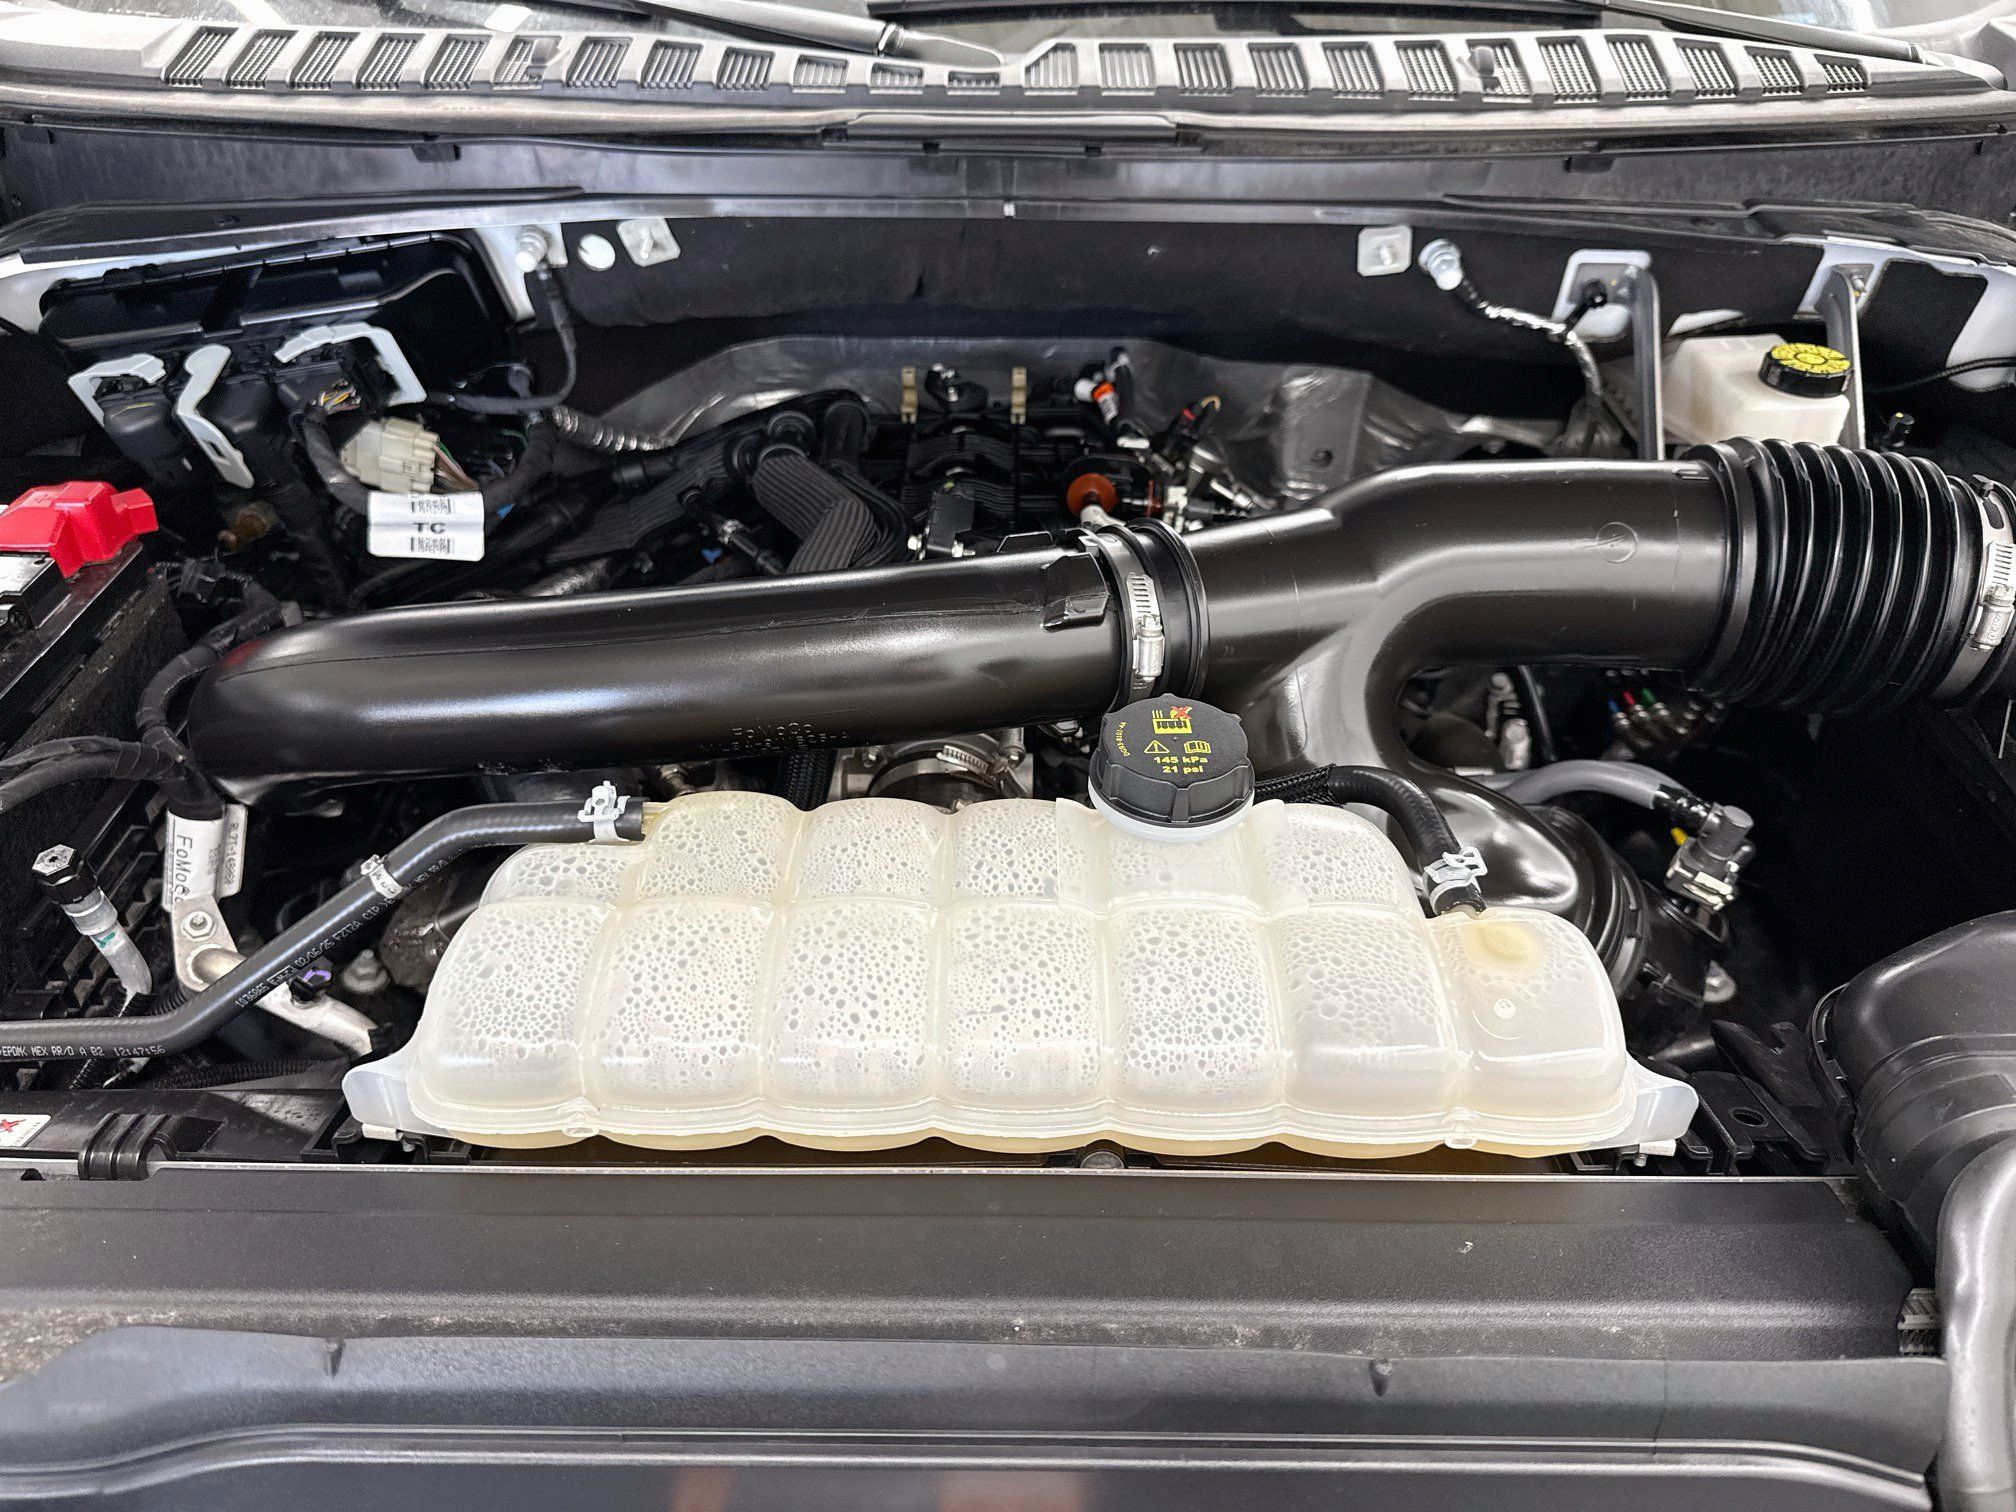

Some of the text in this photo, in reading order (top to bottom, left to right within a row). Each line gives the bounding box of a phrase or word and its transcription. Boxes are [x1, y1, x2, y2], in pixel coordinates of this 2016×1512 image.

[413, 522, 446, 534] TC
[1162, 765, 1204, 774] 21 psi
[31, 1045, 49, 1057] MEX
[79, 1047, 87, 1056] A
